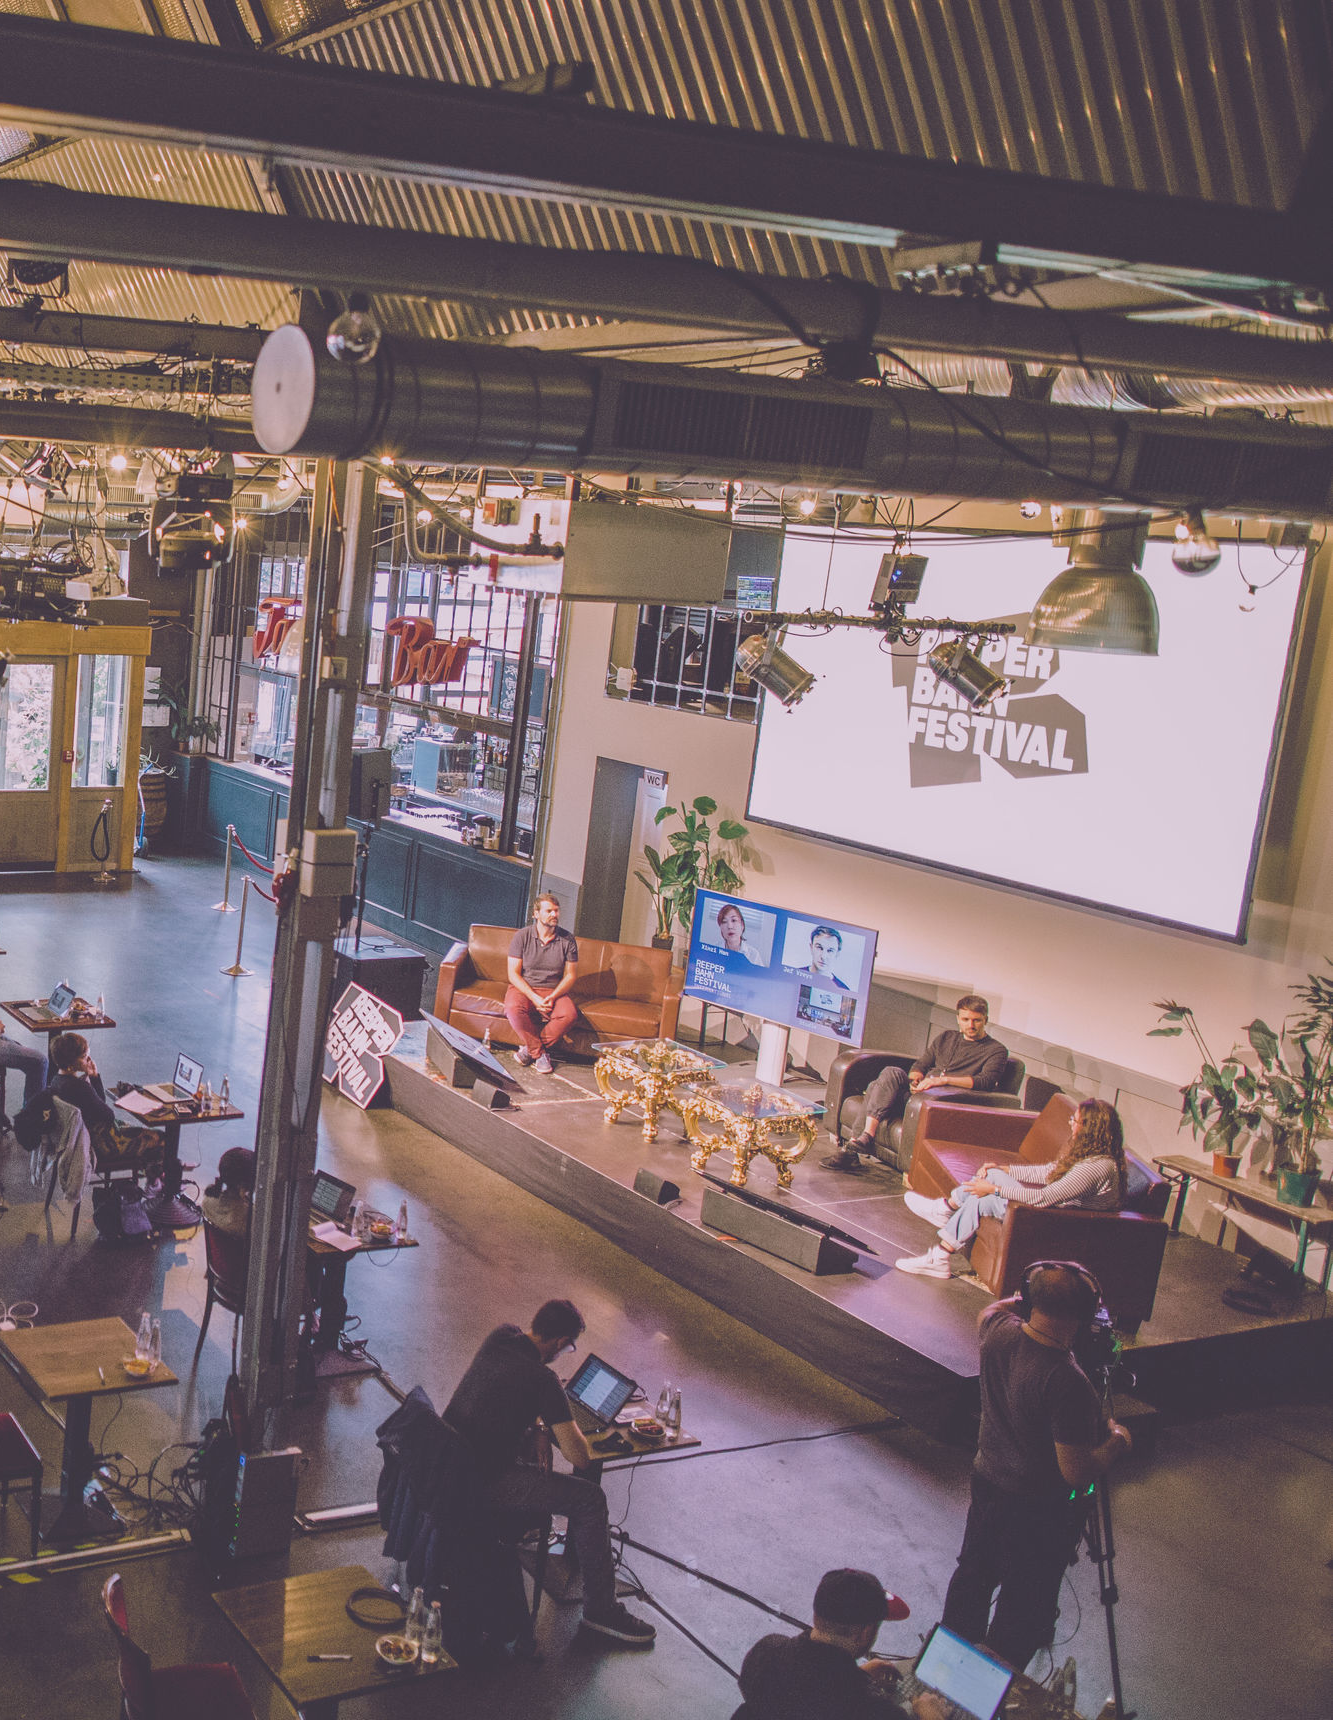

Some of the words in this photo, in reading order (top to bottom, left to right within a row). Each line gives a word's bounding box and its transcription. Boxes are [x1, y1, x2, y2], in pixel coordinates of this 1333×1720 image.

[386, 616, 482, 687] Bar
[912, 667, 1011, 717] BAN
[908, 706, 1074, 771] FESTIVAL
[647, 775, 661, 786] WC
[694, 975, 731, 993] FESTIVAL
[695, 967, 714, 980] BAHN
[696, 959, 725, 974] REEPER
[336, 1007, 373, 1058] BAHN
[350, 992, 396, 1053] REEPER
[326, 1024, 372, 1101] FESTIVAL
